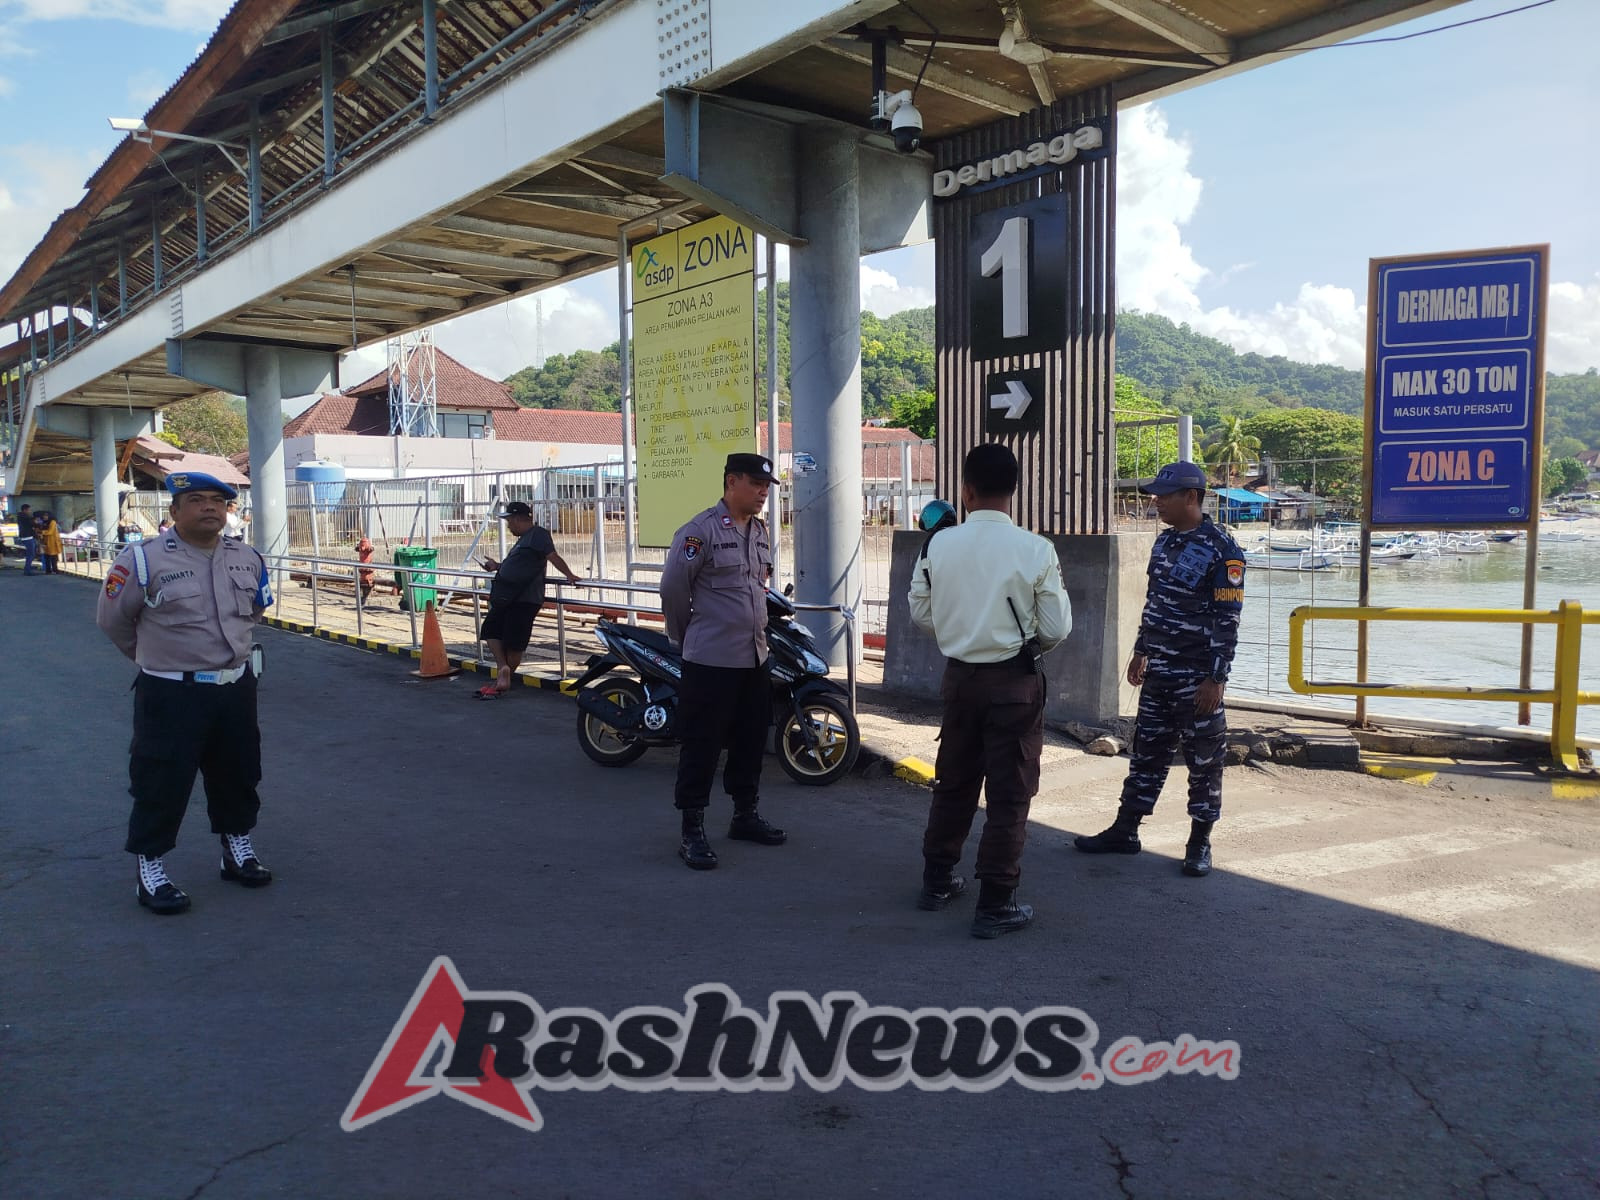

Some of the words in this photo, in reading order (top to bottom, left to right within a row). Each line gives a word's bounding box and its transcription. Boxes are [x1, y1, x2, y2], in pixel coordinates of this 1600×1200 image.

[933, 125, 1103, 197] Dermaga
[684, 226, 748, 272] ZONA
[645, 263, 674, 287] asdp
[981, 216, 1029, 338] 1
[667, 296, 697, 317] ZONA
[699, 291, 713, 311] A3
[1397, 286, 1478, 324] DERMAGA
[1481, 284, 1510, 319] MB
[1512, 283, 1520, 317] I
[645, 325, 660, 336] AREA
[660, 315, 697, 332] PENUMPANG
[725, 304, 742, 316] KAKI
[1392, 370, 1437, 397] MAX
[1442, 368, 1470, 395] 30
[1476, 365, 1518, 393] TON
[1393, 405, 1431, 417] MASUK
[1433, 404, 1461, 416] SATU
[1463, 403, 1513, 415] PERSATU
[720, 427, 750, 439] KORIDOR
[1406, 450, 1471, 482] ZONA
[1477, 449, 1496, 481] C
[160, 570, 195, 584] SUMARTA
